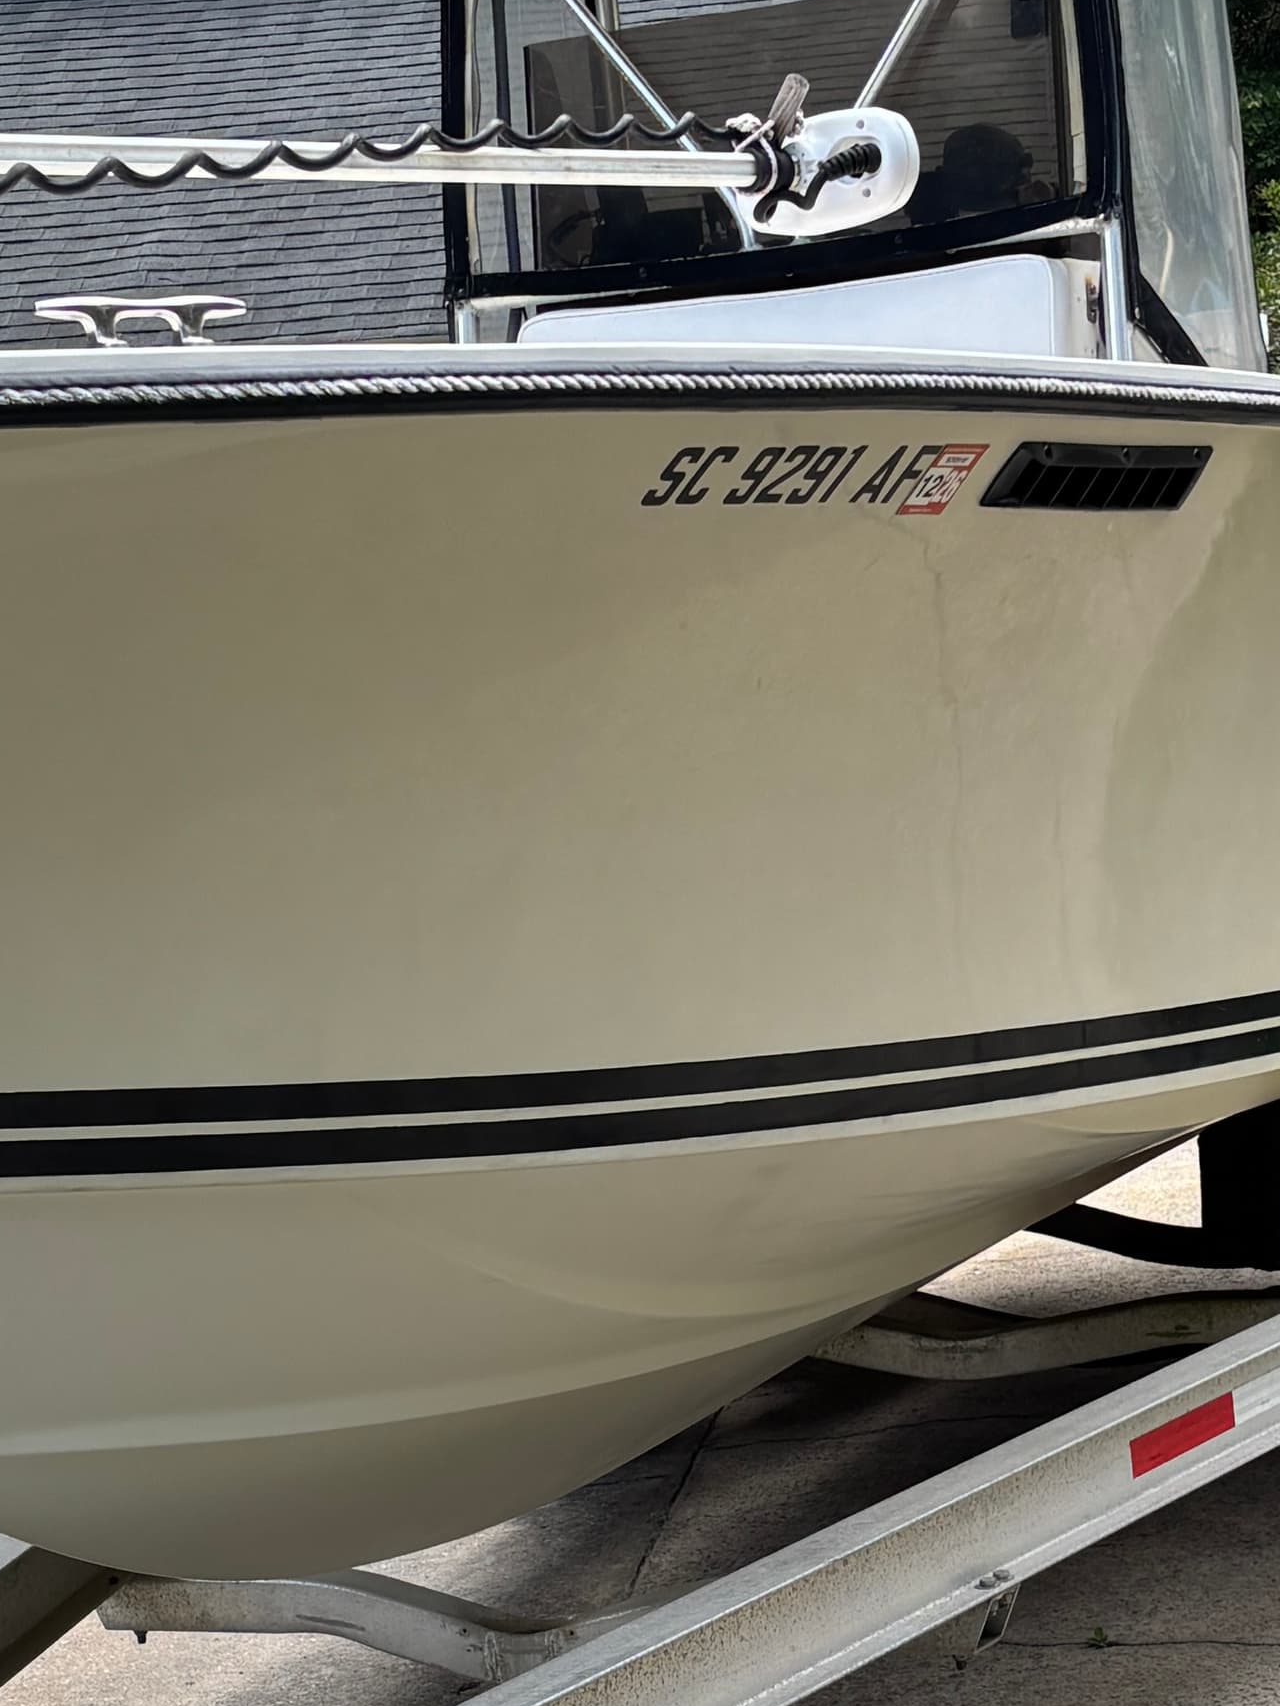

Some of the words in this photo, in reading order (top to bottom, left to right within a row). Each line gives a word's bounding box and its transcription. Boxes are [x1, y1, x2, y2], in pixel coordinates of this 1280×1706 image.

[640, 445, 740, 506] SC
[723, 444, 869, 505] 9291
[848, 444, 944, 505] AF
[915, 474, 944, 499] 12
